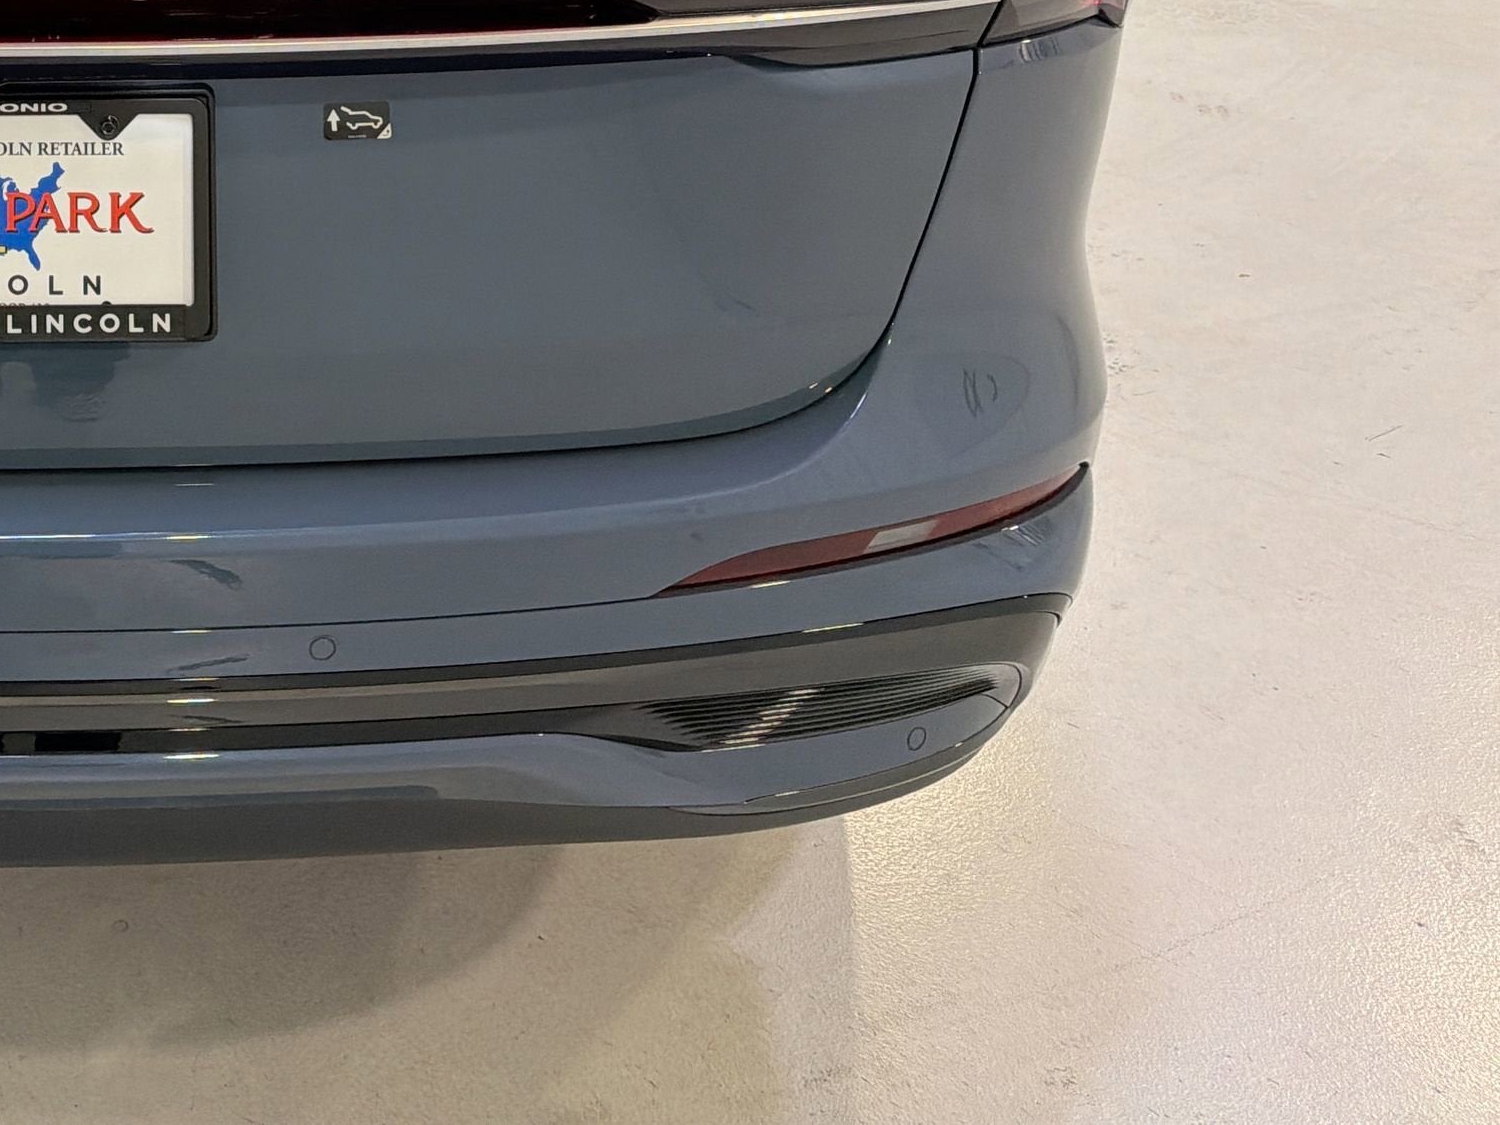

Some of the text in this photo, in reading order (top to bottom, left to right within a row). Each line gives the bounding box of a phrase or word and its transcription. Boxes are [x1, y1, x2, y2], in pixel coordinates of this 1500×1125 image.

[38, 141, 124, 156] RETAILER
[5, 192, 155, 234] PARK
[7, 313, 171, 334] LINCOLN
